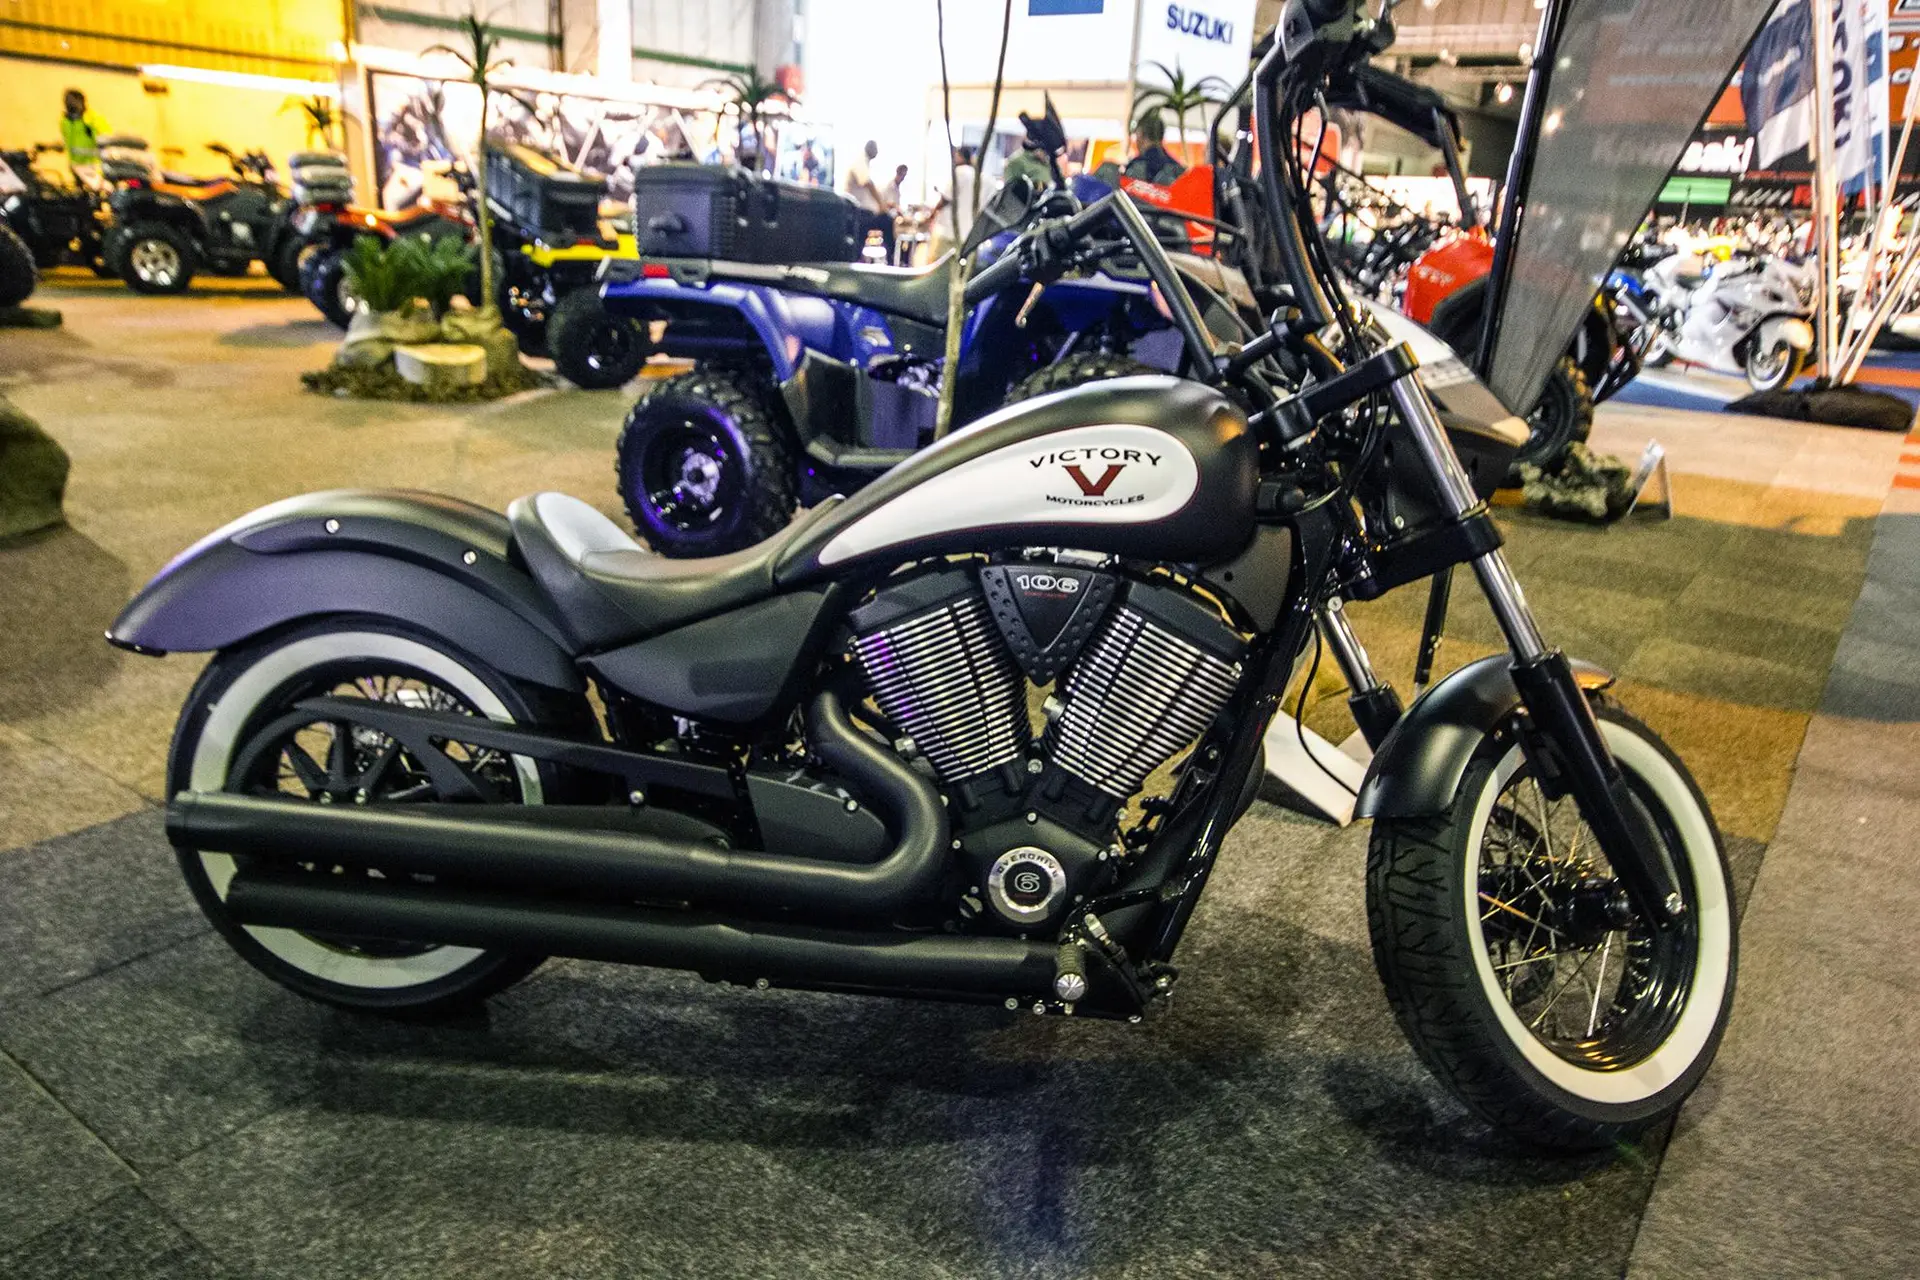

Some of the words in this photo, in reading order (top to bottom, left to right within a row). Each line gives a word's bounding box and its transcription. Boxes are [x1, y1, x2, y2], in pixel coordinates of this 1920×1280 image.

[1167, 4, 1234, 44] SUZUKI
[1030, 448, 1162, 468] VICTORY
[1062, 464, 1127, 496] V
[1046, 494, 1145, 506] MOTORCYCLES
[1017, 575, 1079, 593] 106
[997, 853, 1058, 878] OVERDRIVE
[1014, 872, 1040, 892] 6
